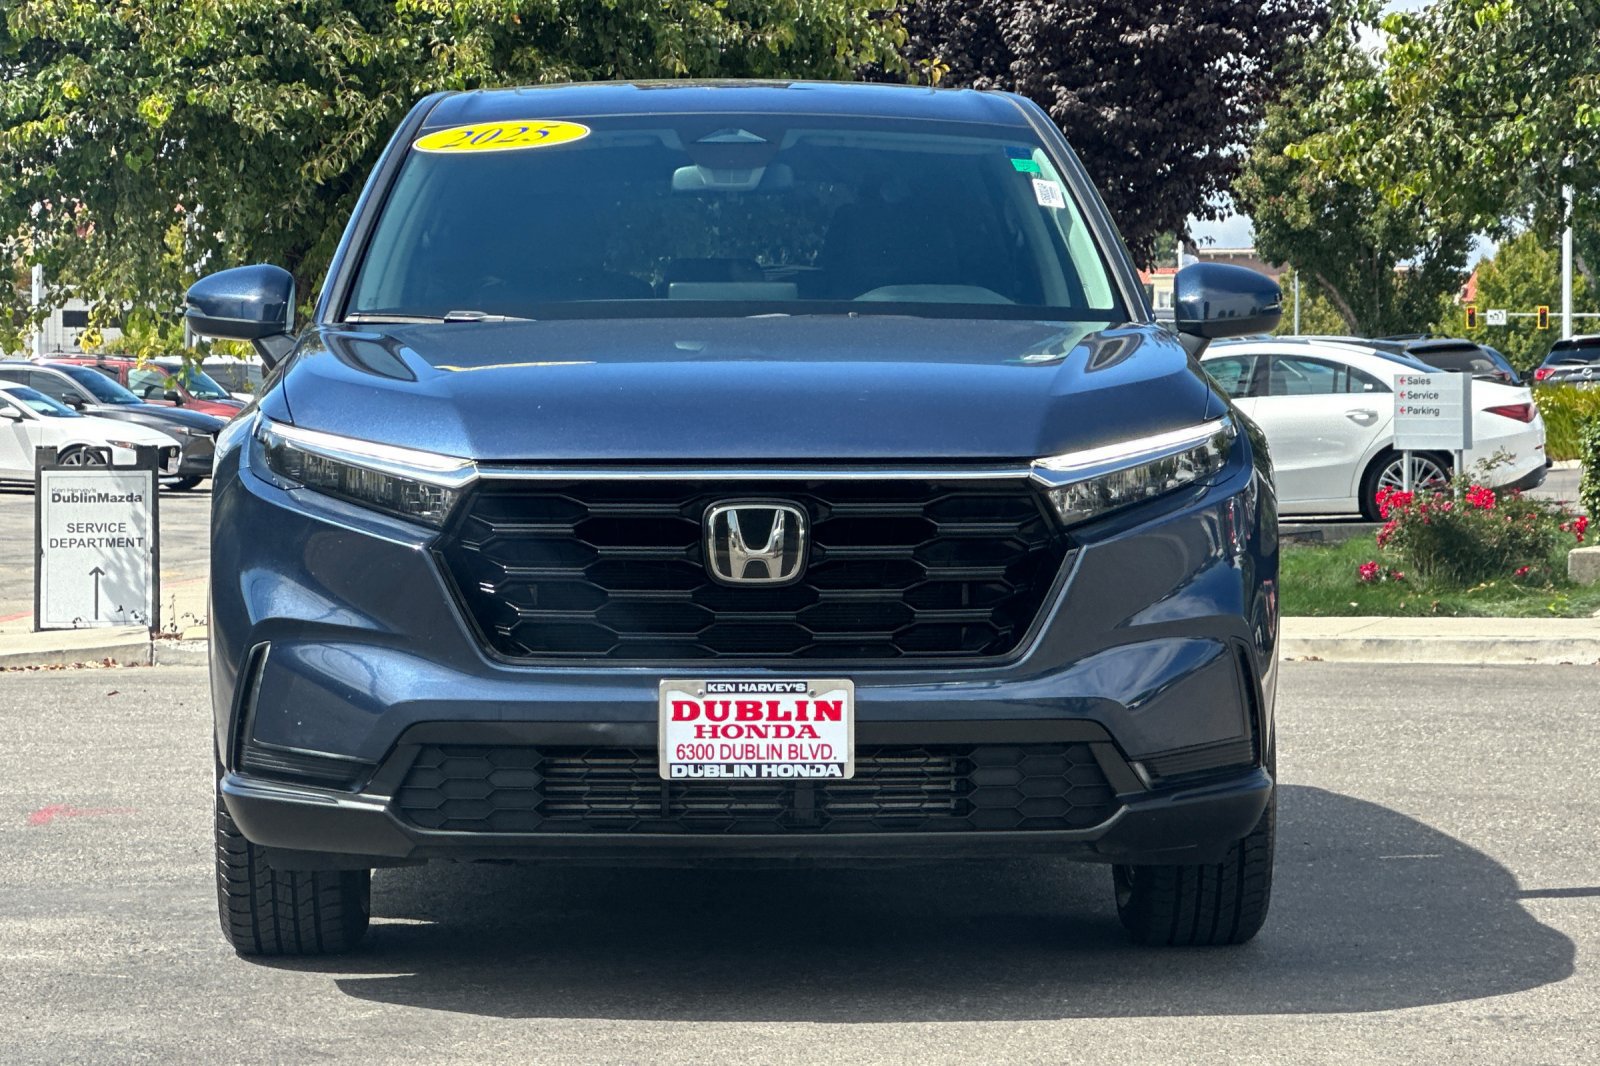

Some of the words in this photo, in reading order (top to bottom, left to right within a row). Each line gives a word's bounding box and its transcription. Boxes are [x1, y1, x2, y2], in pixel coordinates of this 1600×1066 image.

[439, 125, 560, 148] 2025
[1407, 376, 1431, 385] Sales
[1407, 390, 1439, 400] Service
[1407, 406, 1440, 417] Parking
[51, 493, 143, 503] DublinMazda
[66, 522, 127, 533] SERVICE
[50, 537, 144, 549] DEPARTMENT
[707, 683, 736, 692] KEN
[738, 683, 807, 692] HARVEY'S
[671, 700, 843, 722] DUBLIN
[694, 724, 821, 739] HONDA
[676, 743, 715, 761] 6300
[719, 743, 783, 761] DUBLIN
[788, 743, 837, 761] BLVD.
[671, 764, 757, 778] DUBLIN
[761, 764, 842, 778] HONDA
